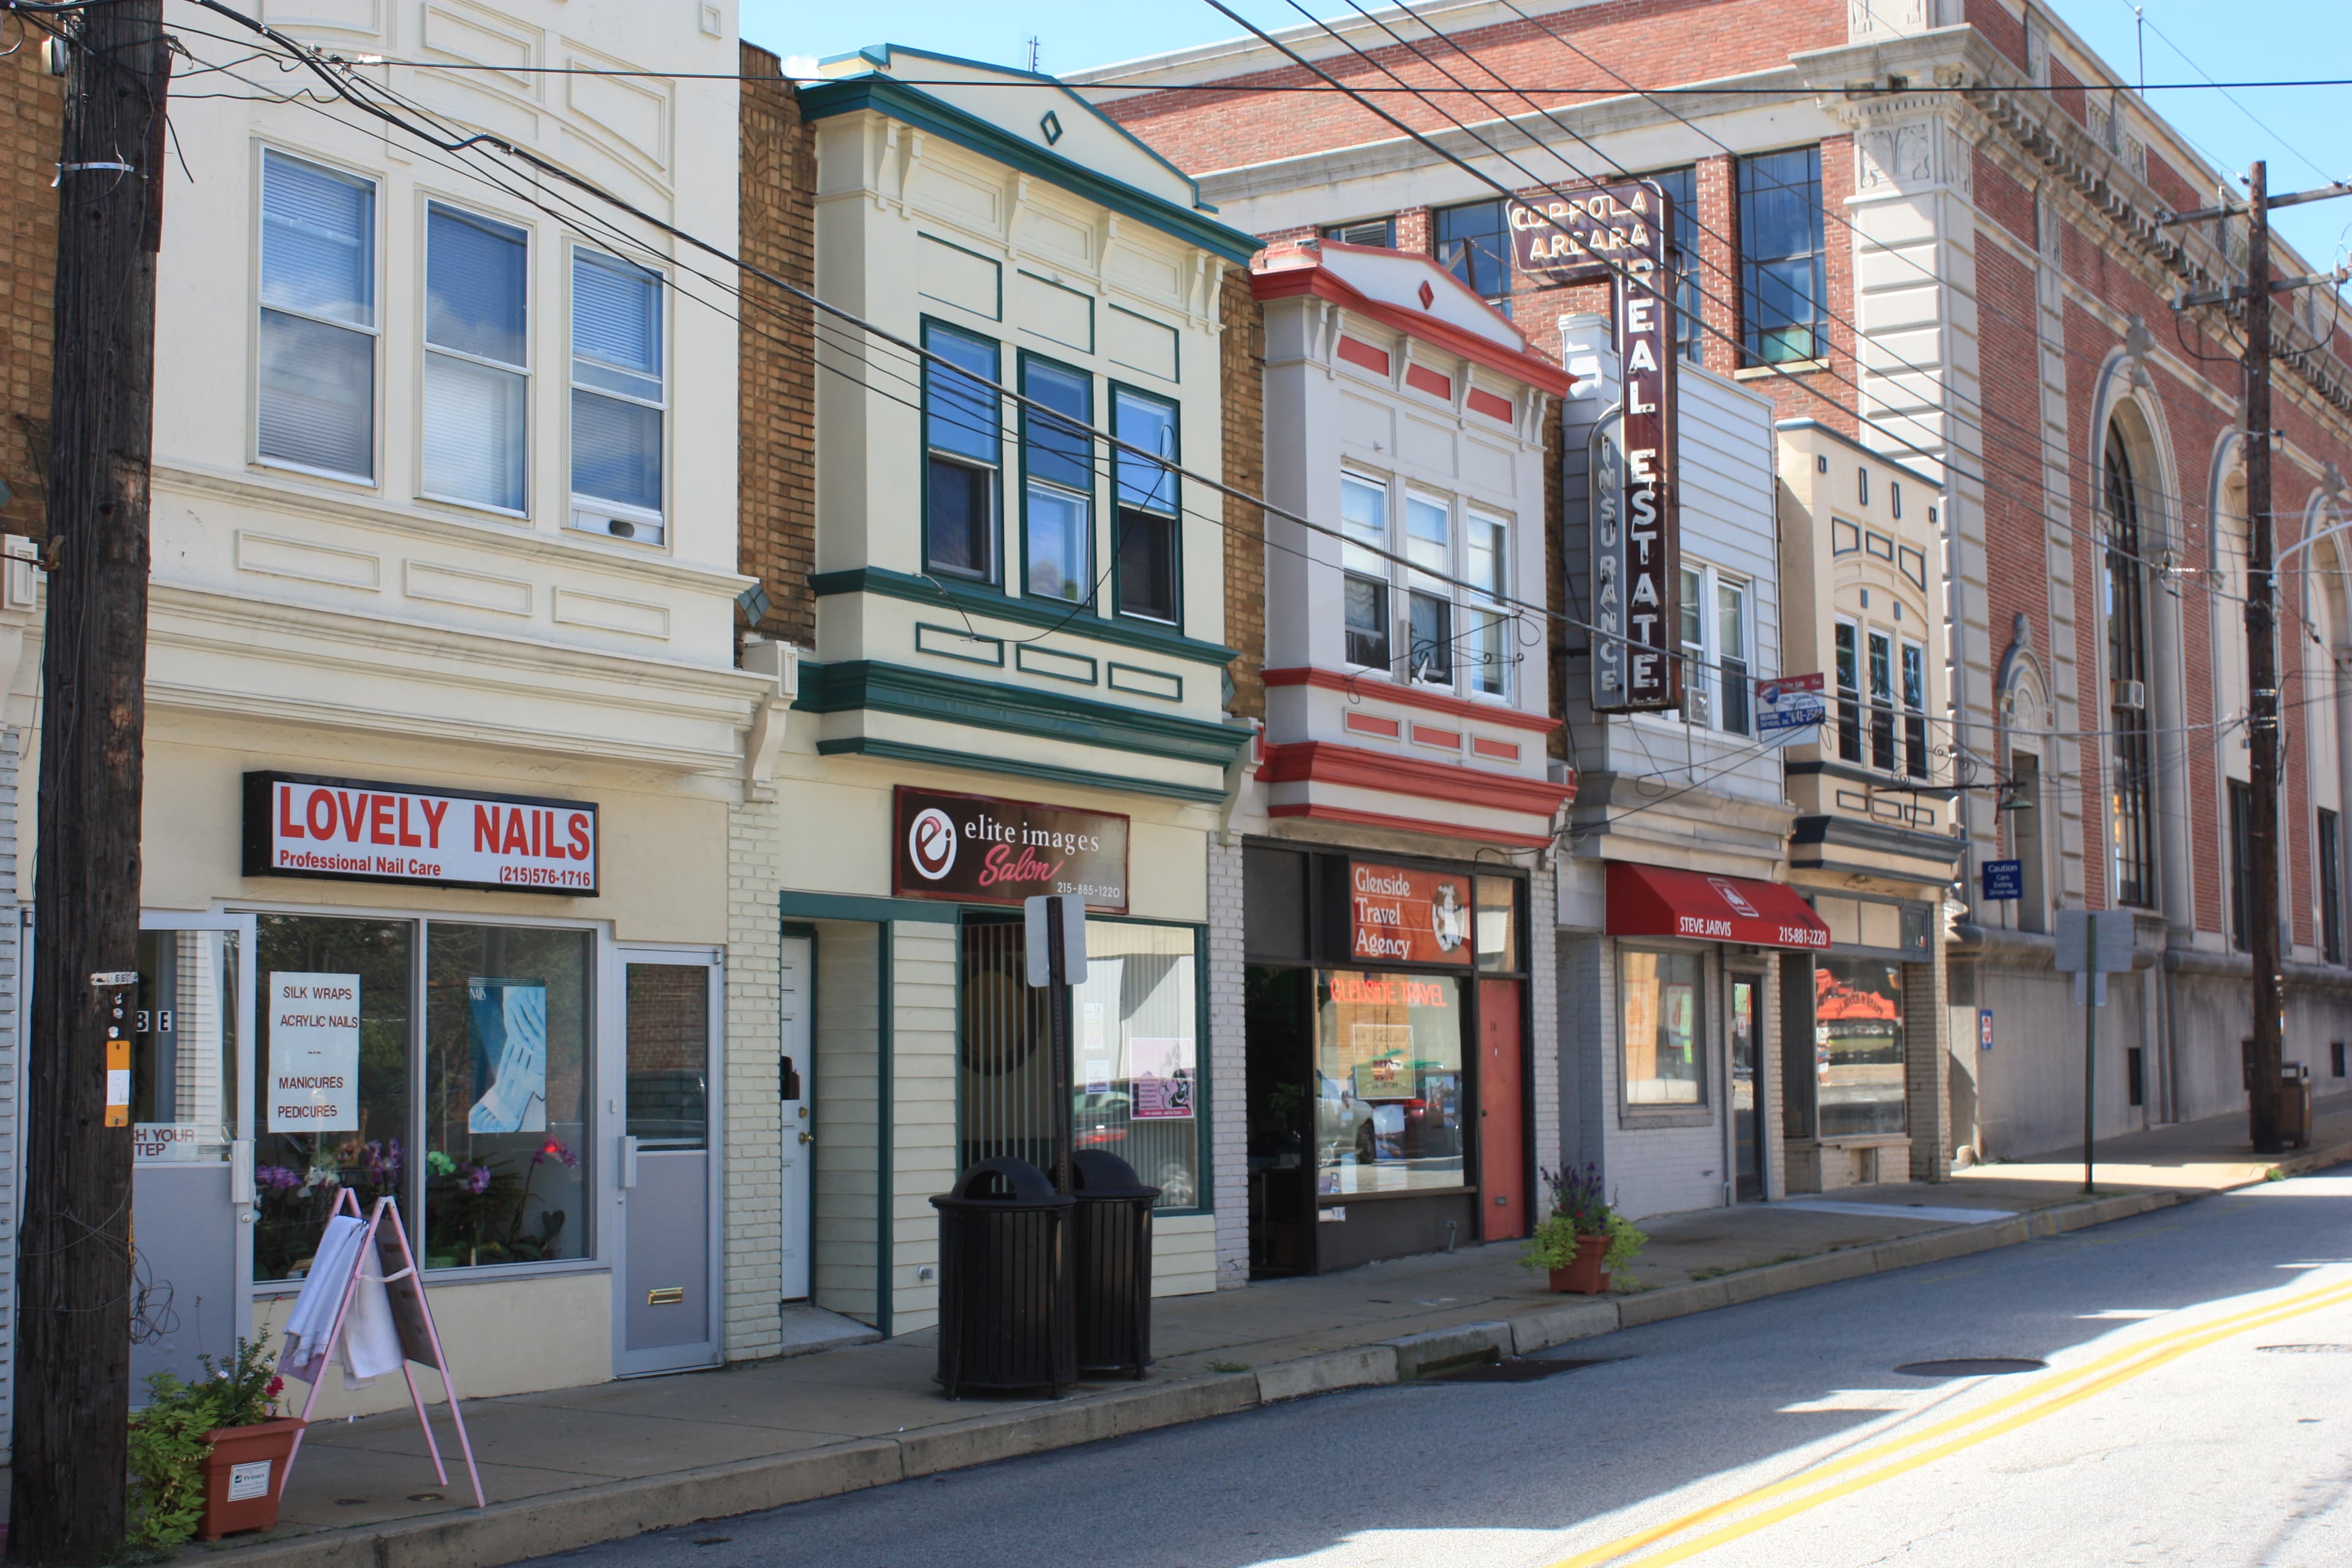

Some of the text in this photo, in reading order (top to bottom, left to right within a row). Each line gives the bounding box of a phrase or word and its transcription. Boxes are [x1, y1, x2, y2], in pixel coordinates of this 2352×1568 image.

[1511, 190, 1649, 232] COPPOLA
[1529, 224, 1651, 262] ARCARA
[1627, 258, 1657, 415] REAL
[1598, 435, 1618, 692] INSURANCE
[1630, 449, 1659, 688] ESTATE
[279, 785, 590, 861] LOVELY NAILS
[964, 814, 1099, 855] elite images
[279, 849, 442, 876] Professional Nail Care
[499, 865, 591, 886] (215)576-1716
[978, 843, 1064, 887] Salon
[1988, 864, 2018, 873] Caution
[1057, 881, 1120, 898] 215-885-1220
[1355, 867, 1411, 897] Glenside
[1355, 897, 1401, 925] Travel
[1679, 916, 1732, 937] STEVE JARVIS
[1778, 926, 1827, 946] 215-881-2220
[1355, 928, 1411, 960] Agency
[283, 986, 352, 1000] SILK WRAPS
[1329, 978, 1447, 1007] GLENSIDE TRAVEL
[280, 1014, 358, 1028] ACRYLIC NAILS
[279, 1076, 344, 1089] MANICURES
[278, 1105, 337, 1118] PEDICURES
[152, 1128, 195, 1142] YOUR
